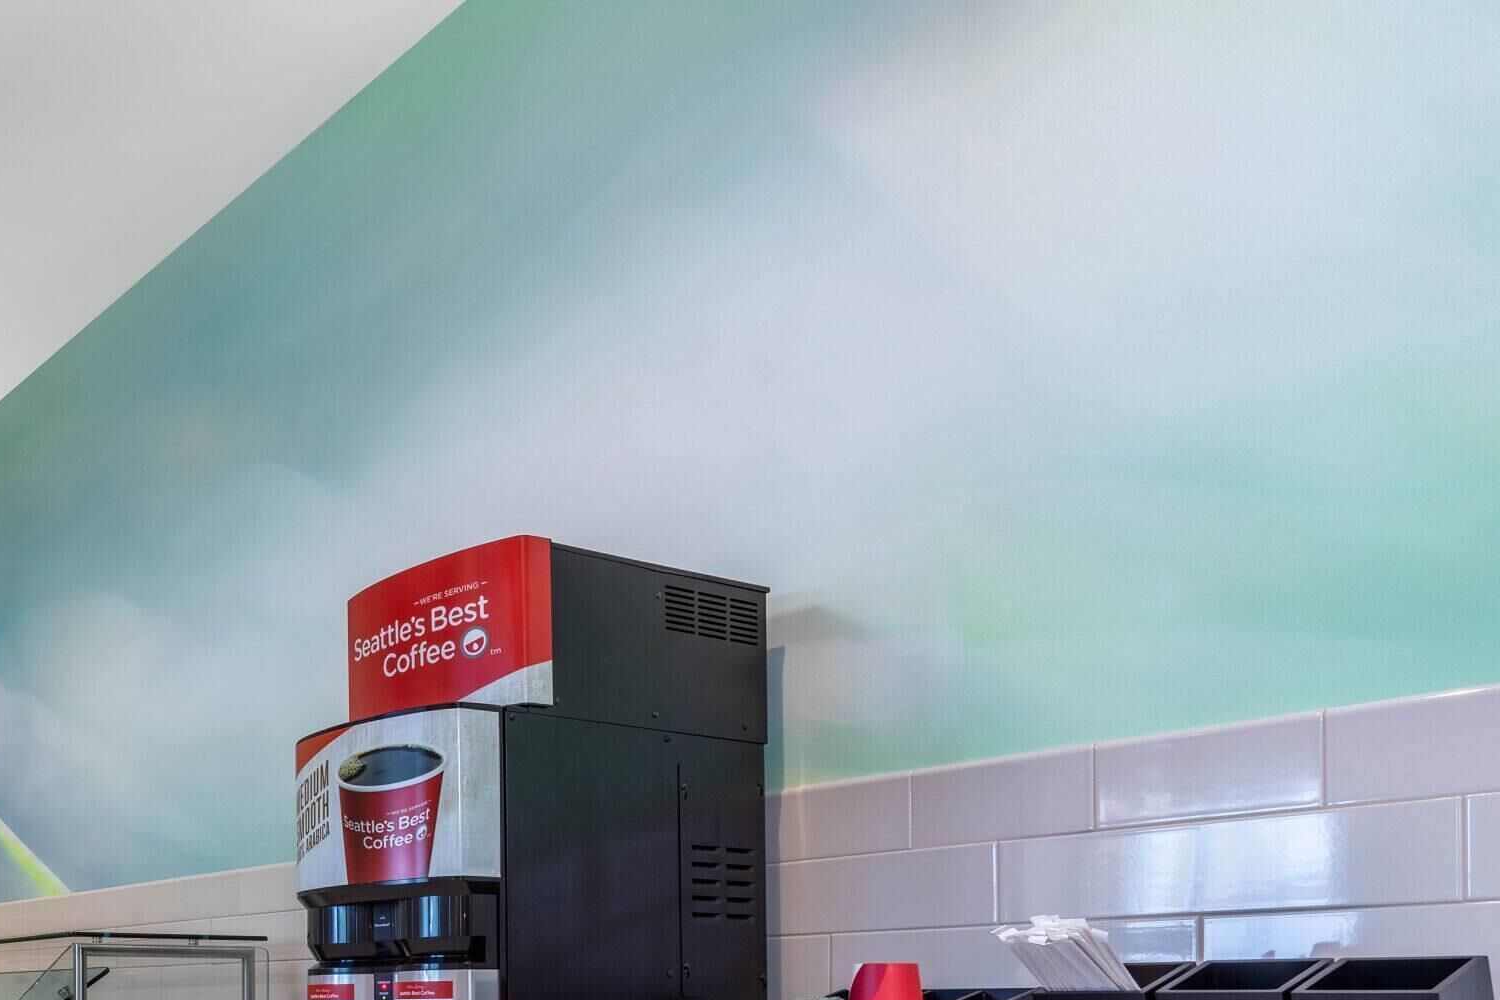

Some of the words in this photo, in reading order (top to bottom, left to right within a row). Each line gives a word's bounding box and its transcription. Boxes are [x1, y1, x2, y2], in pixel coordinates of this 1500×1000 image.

[444, 581, 479, 598] SERVING
[354, 616, 426, 662] Seattle's
[431, 595, 489, 632] Best
[383, 640, 456, 677] Coffee
[343, 815, 395, 834] Seattle's
[398, 807, 430, 829] Best
[363, 833, 413, 849] Coffee
